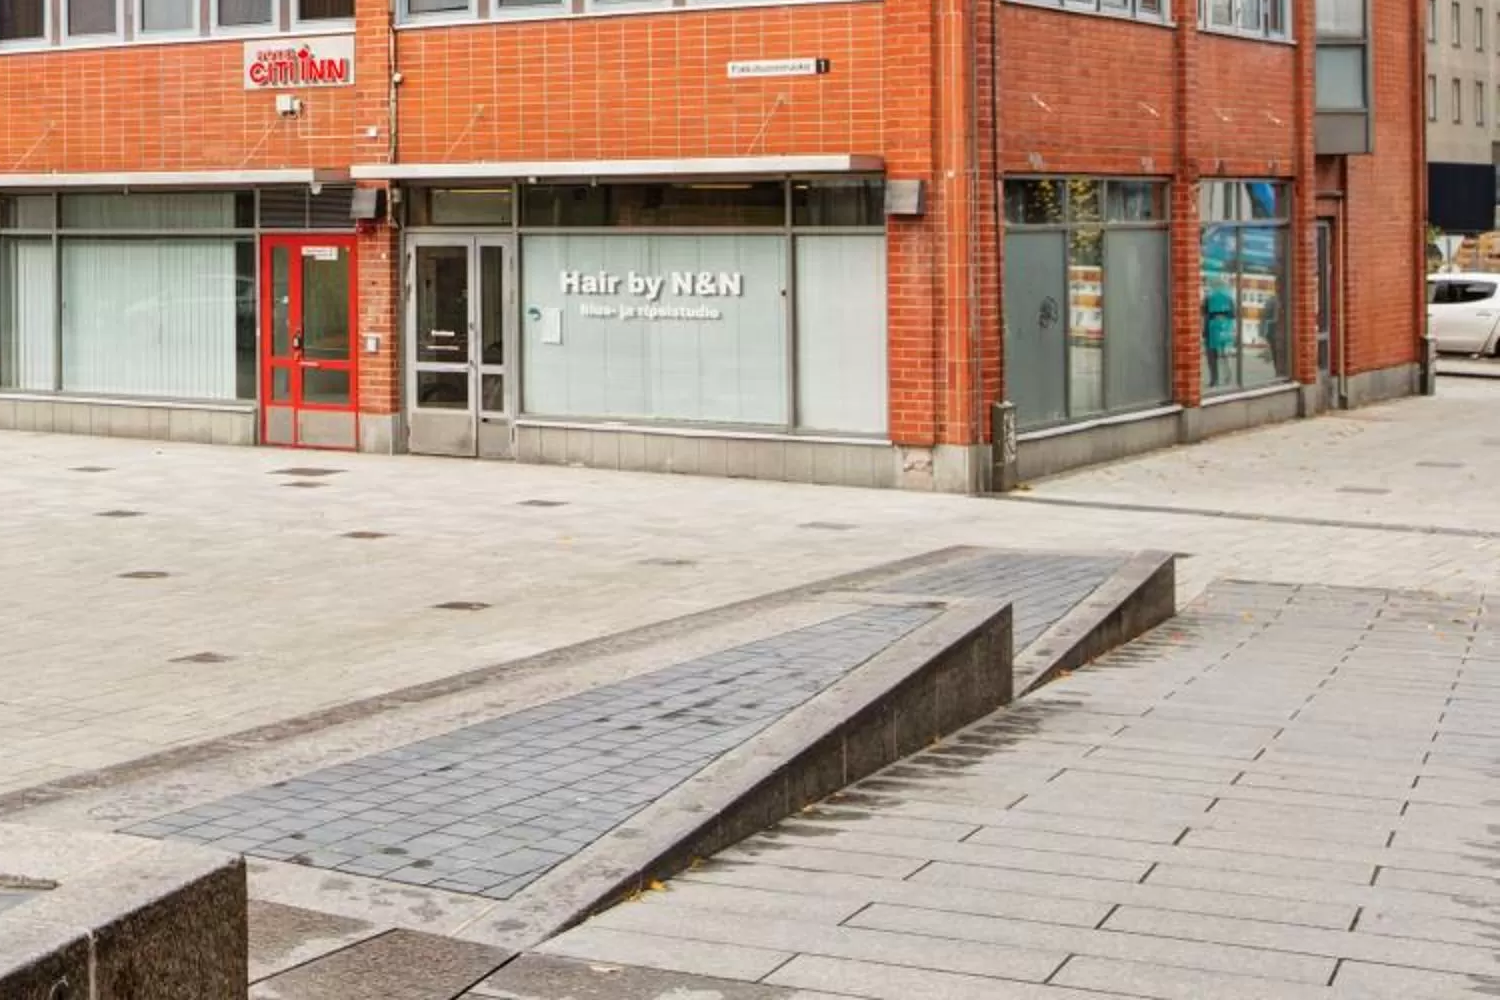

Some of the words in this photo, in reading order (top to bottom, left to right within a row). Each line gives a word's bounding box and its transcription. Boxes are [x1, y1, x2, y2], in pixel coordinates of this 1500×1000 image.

[250, 60, 296, 84] CITI
[299, 52, 347, 82] INN
[560, 270, 620, 294] Hair
[627, 270, 663, 299] by
[671, 270, 743, 296] N&N
